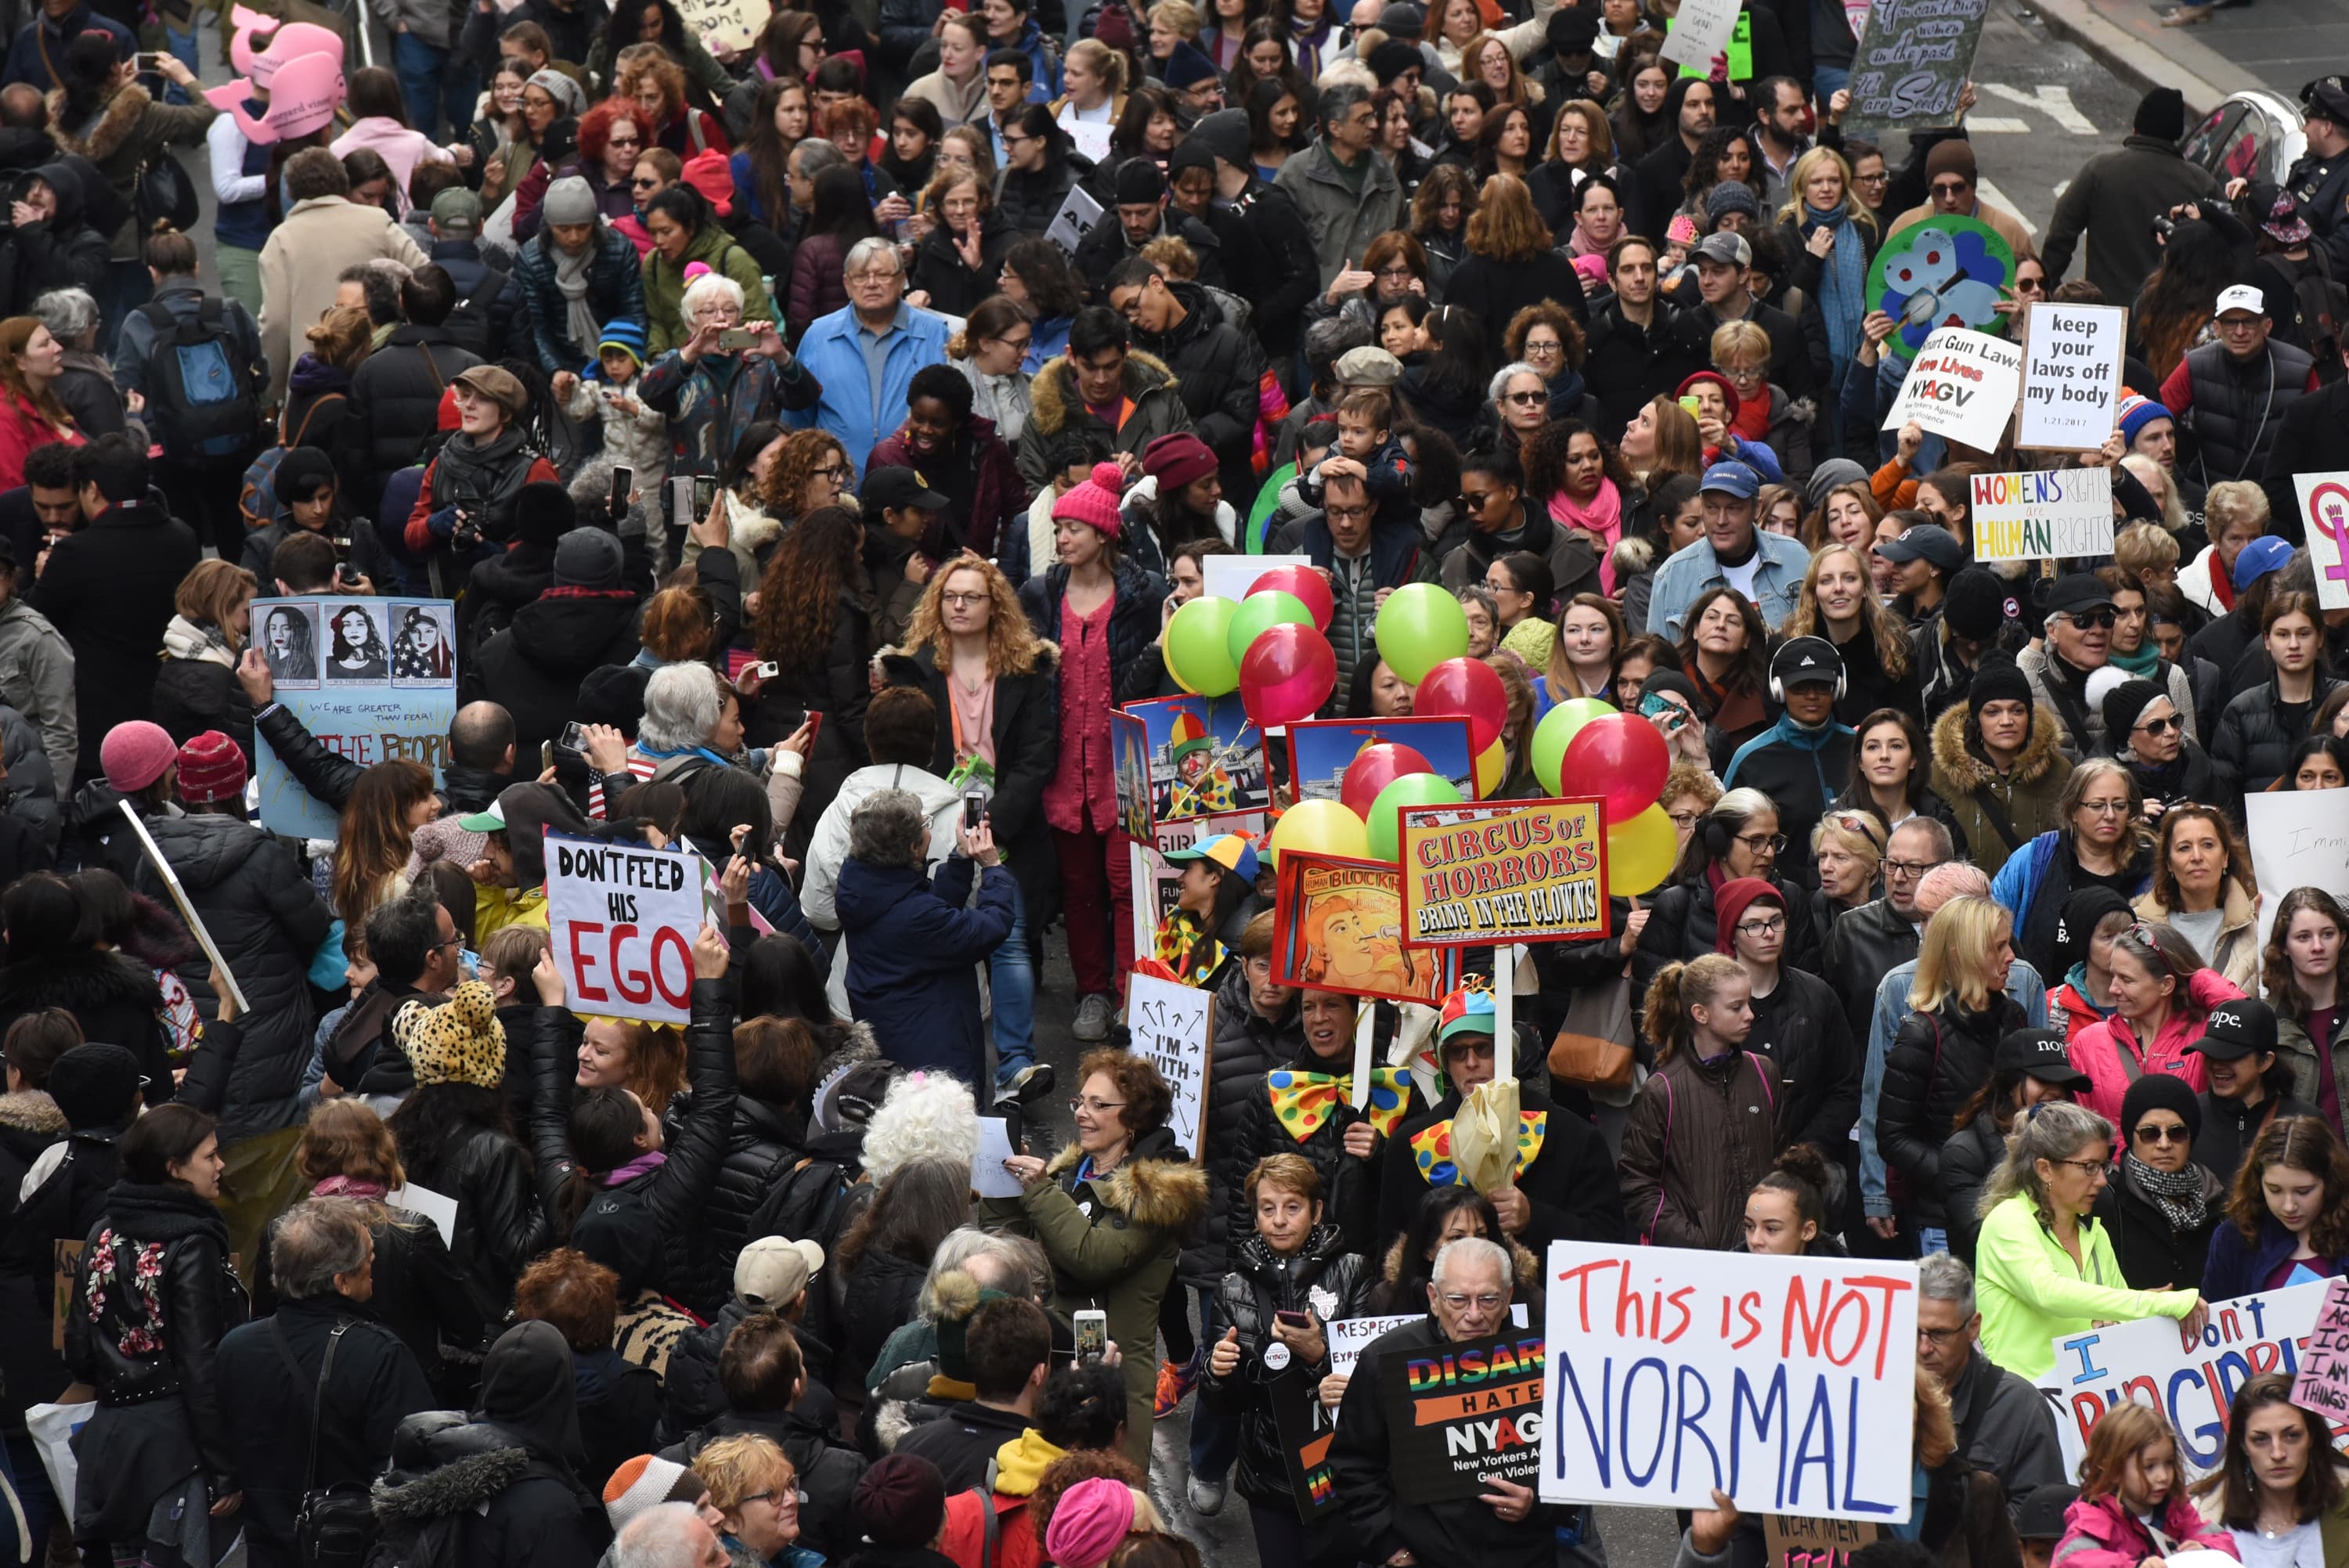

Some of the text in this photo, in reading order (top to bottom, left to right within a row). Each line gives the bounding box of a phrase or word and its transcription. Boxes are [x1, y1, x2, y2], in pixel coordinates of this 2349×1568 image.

[1919, 23, 1960, 36] women
[1873, 50, 1886, 62] in
[1893, 31, 1916, 61] the
[1864, 99, 1890, 110] are
[2051, 314, 2098, 339] keep
[1945, 335, 1975, 354] Gun
[2050, 341, 2095, 359] your
[1939, 356, 1983, 382] Lives
[2032, 358, 2109, 380] laws off
[1908, 380, 1975, 408] NYAGV
[2027, 386, 2055, 404] my
[2062, 384, 2109, 409] body
[1916, 413, 1945, 425] Violence
[1934, 406, 1964, 420] Against
[2044, 416, 2087, 427] 1.21.2017
[2066, 467, 2112, 503] RIGHTS
[2026, 506, 2044, 517] are
[1975, 514, 2113, 558] HUMAN RIGHTS
[309, 703, 402, 714] WE ARE GREATER
[374, 713, 400, 722] THAN
[1416, 814, 1586, 868] CIRCUS OF
[558, 845, 684, 892] DON'T FEED
[1420, 842, 1597, 905] HORRORS
[1305, 878, 1328, 891] HUMAN
[608, 892, 639, 923] HIS
[1416, 878, 1597, 934] BRING IN THE CLOWNS
[568, 919, 696, 1011] EGO
[1156, 1034, 1181, 1057] I'M
[1558, 1259, 1697, 1345] This
[1781, 1275, 1912, 1381] NOT
[2314, 1328, 2337, 1348] I
[2064, 1335, 2108, 1385] I
[2304, 1352, 2330, 1375] I
[1461, 1383, 1542, 1413] HATE
[2300, 1378, 2348, 1410] THINGS
[1557, 1351, 1900, 1514] NORMAL
[1453, 1459, 1480, 1472] New
[1482, 1451, 1528, 1468] Yorkers
[1822, 1518, 1860, 1545] MEN
